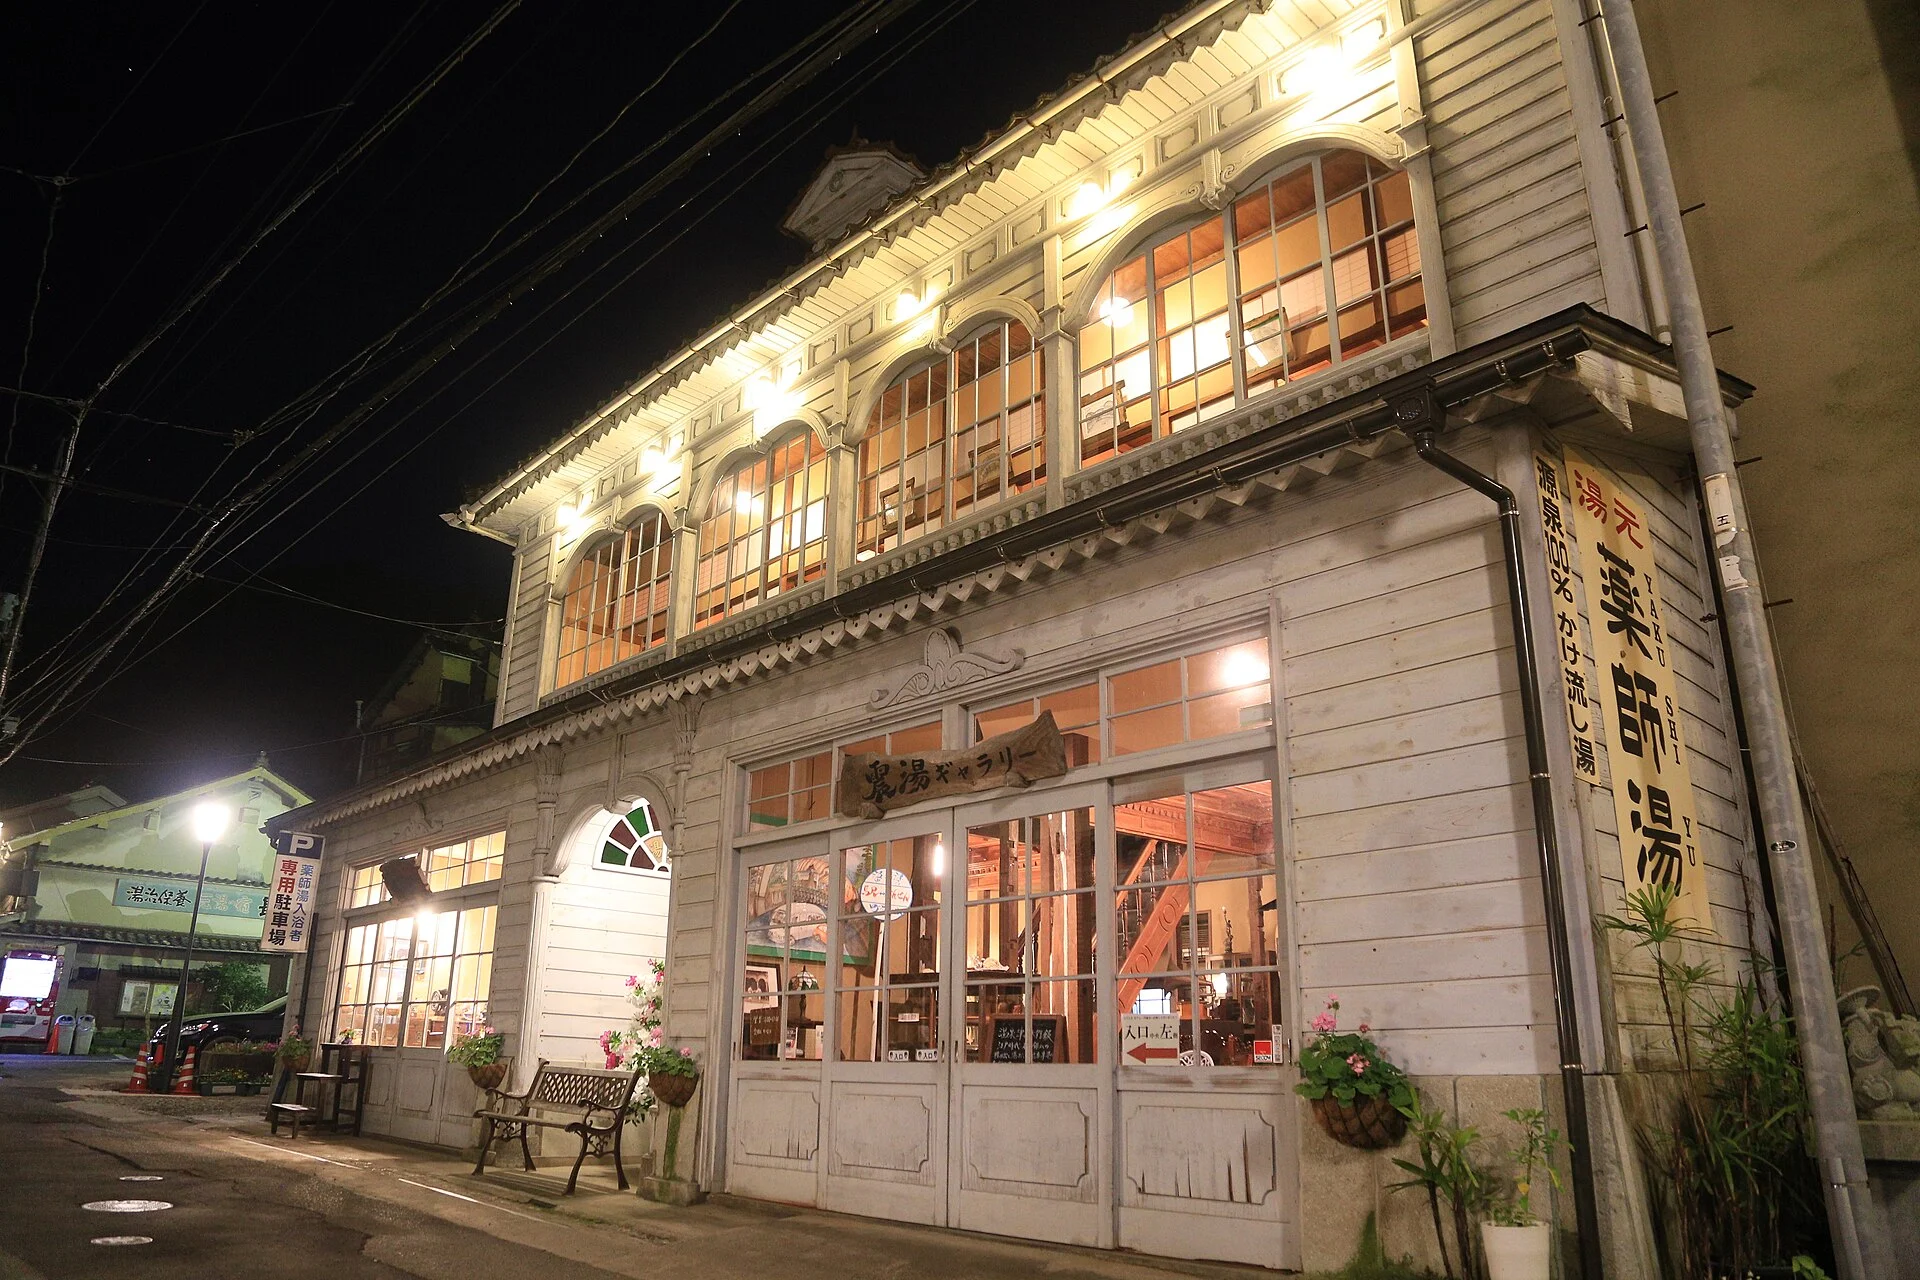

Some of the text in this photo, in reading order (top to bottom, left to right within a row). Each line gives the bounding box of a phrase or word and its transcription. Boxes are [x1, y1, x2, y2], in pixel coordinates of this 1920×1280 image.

[1574, 469, 1644, 550] 湯元
[1597, 541, 1683, 896] 薬師湯
[1644, 573, 1696, 867] YAKU SHI YU
[289, 834, 314, 854] P
[126, 885, 192, 907] 湯治保養
[268, 859, 298, 946] 専用駐車場
[289, 864, 314, 942] 薬師湯入浴者
